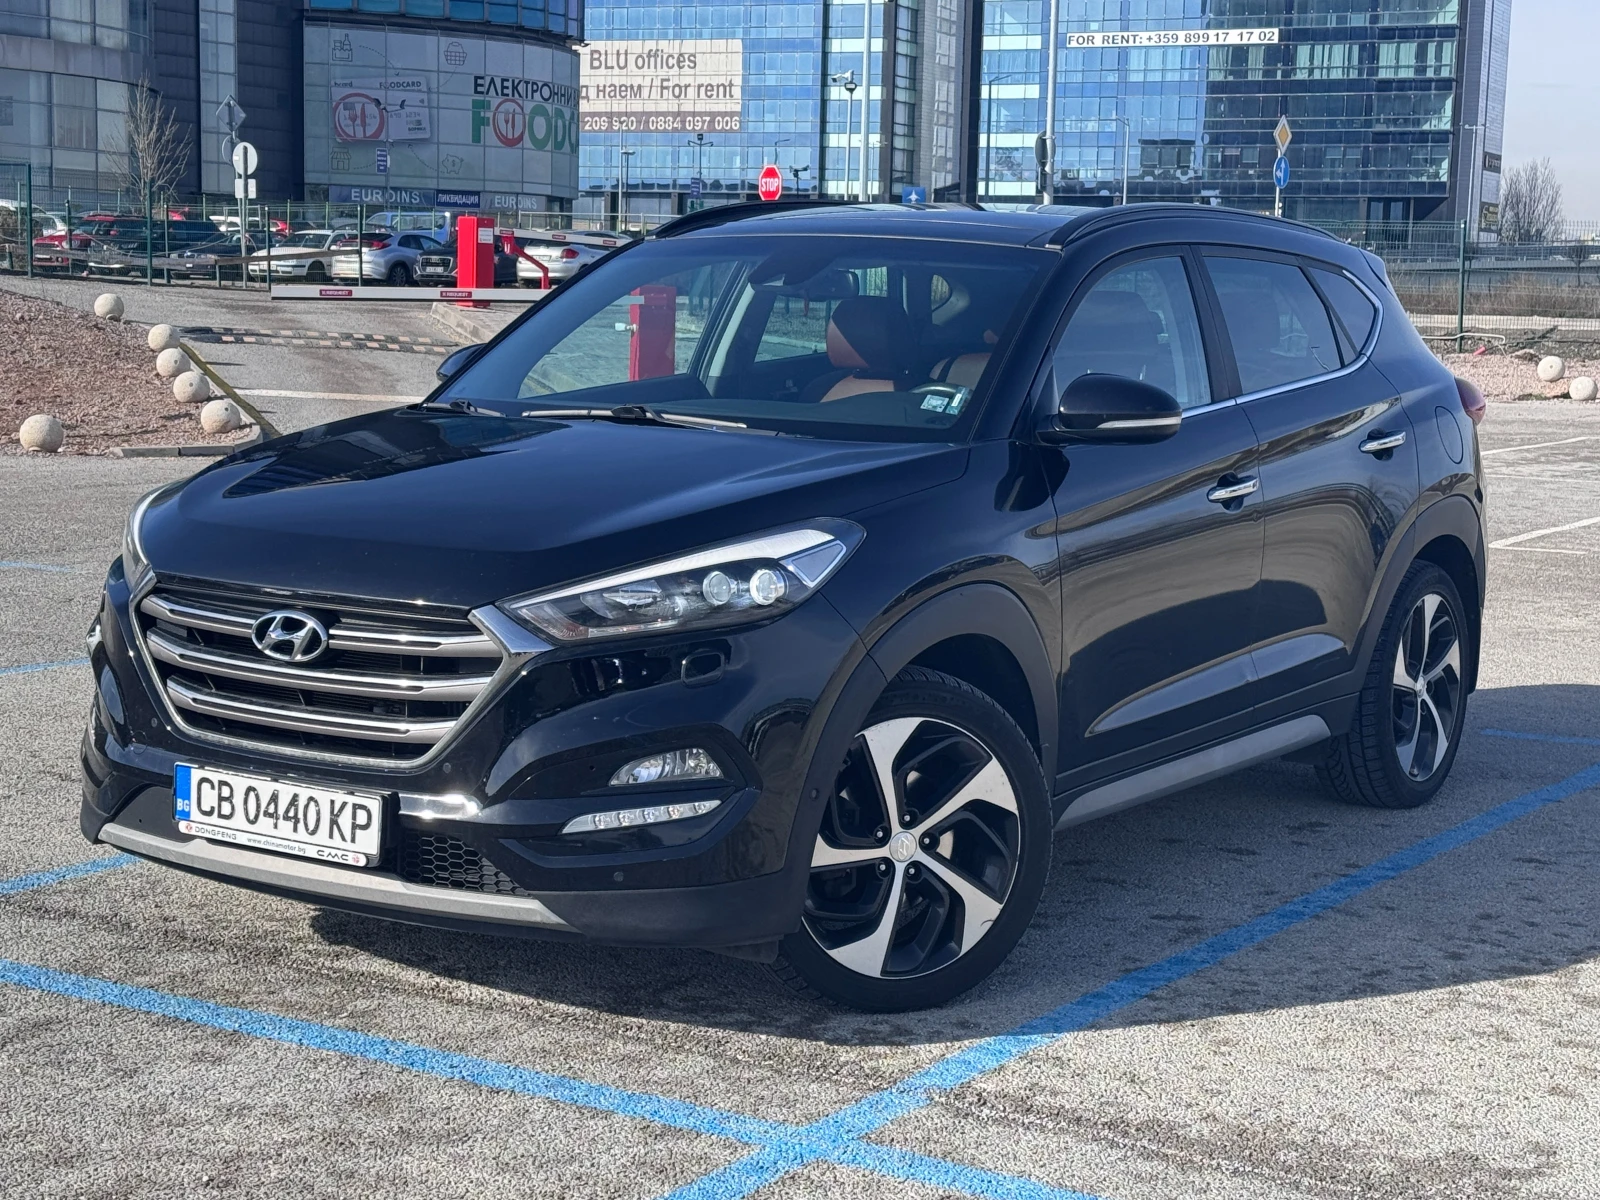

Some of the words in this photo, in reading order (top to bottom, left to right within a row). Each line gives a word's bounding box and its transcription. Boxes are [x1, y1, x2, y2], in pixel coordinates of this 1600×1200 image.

[1068, 35, 1095, 46] FOR
[1102, 33, 1143, 45] RENT:
[1146, 32, 1179, 44] +359
[1184, 31, 1210, 43] 899
[1214, 31, 1230, 43] 17
[1237, 31, 1254, 42] 17
[1258, 30, 1275, 42] 02
[589, 49, 629, 70] BLU
[634, 50, 697, 70] offices
[596, 82, 642, 99] наем
[660, 78, 691, 99] For
[696, 77, 734, 99] rent
[584, 117, 608, 131] 209
[612, 117, 637, 131] 920
[650, 117, 682, 131] 0884
[685, 117, 711, 130] 097
[714, 116, 740, 130] 006
[761, 177, 779, 192] STOP
[351, 188, 420, 204] EUROINS
[437, 193, 479, 205] ЛИКВИДАЦИЯ
[494, 195, 538, 210] EUROINS
[176, 798, 190, 812] BG
[196, 777, 236, 821] CB
[243, 785, 321, 836] 0440
[328, 798, 373, 844] KP
[194, 825, 237, 841] DONGFENG
[246, 836, 306, 854] www.chinamotor.bg
[316, 849, 349, 862] CMC
